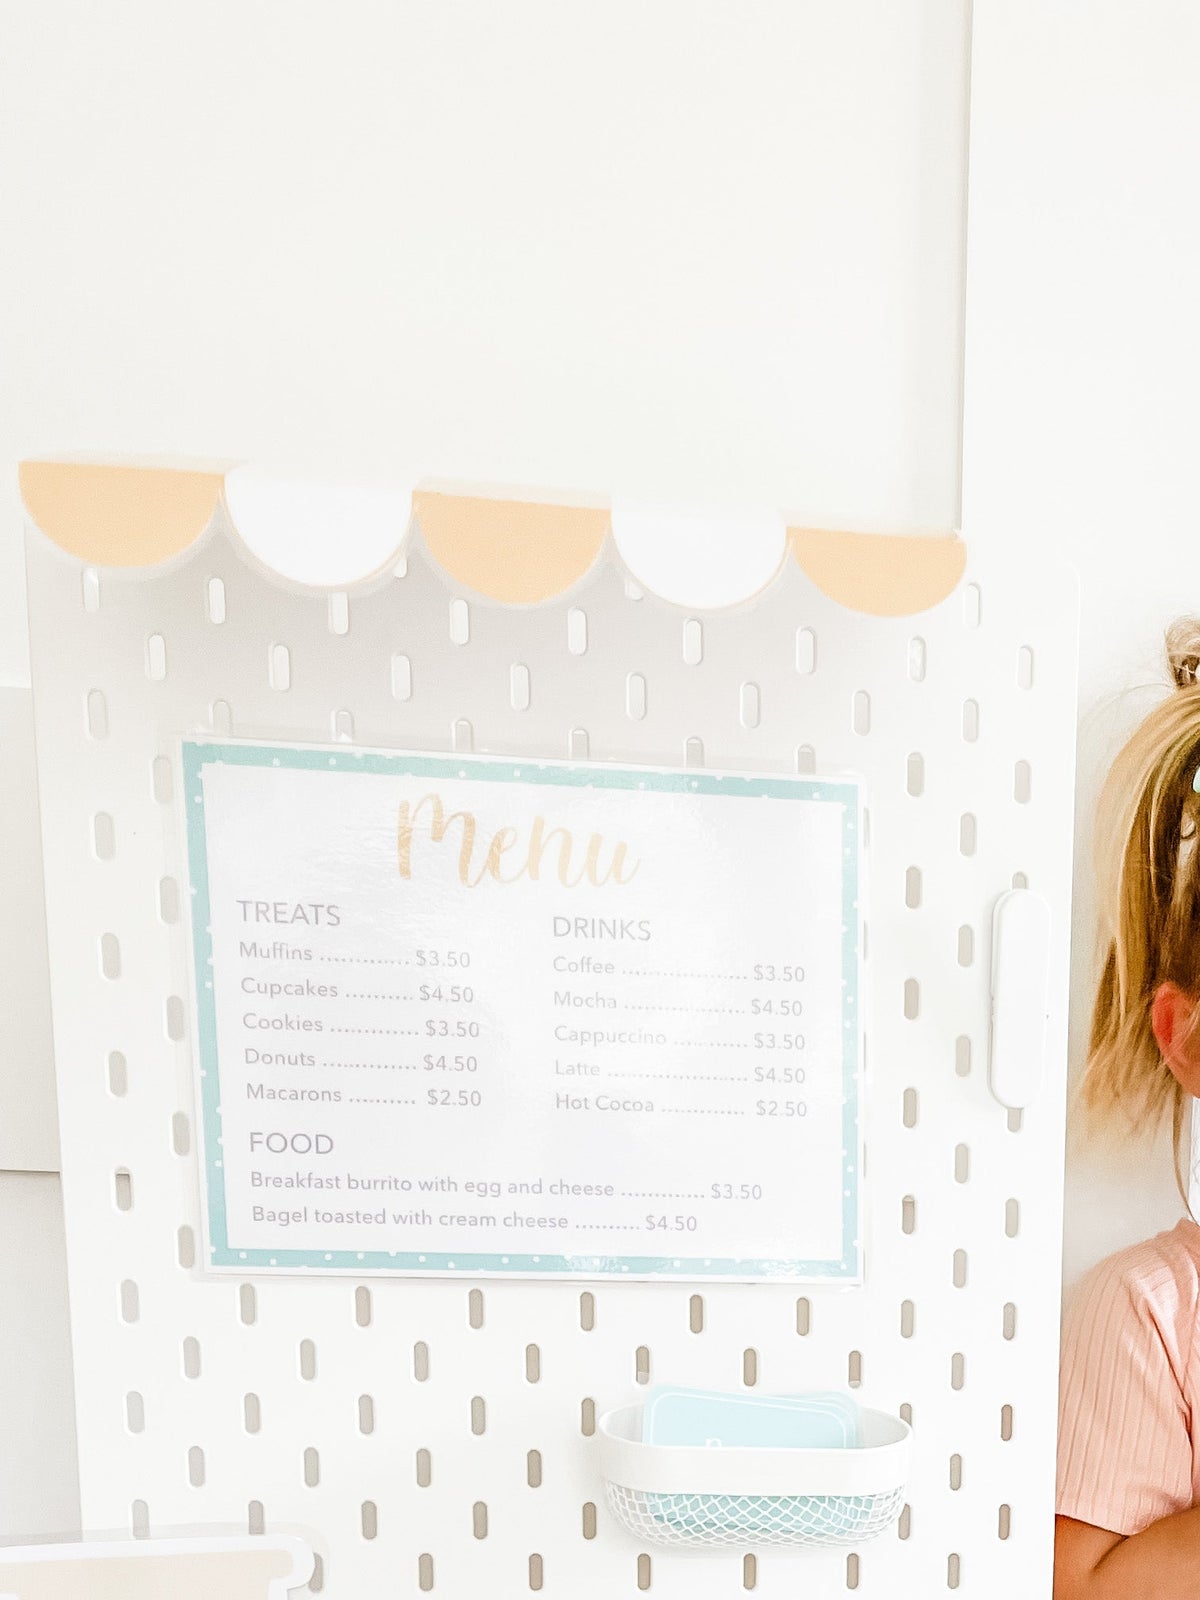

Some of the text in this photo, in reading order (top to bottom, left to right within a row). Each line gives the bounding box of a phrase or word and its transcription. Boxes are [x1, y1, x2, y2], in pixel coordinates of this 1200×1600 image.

[396, 792, 642, 889] Menu
[235, 899, 341, 927] TREATS
[552, 915, 652, 941] DRINKS
[239, 941, 471, 969] Muffins $3.50
[552, 956, 806, 983] Coffee $3.50
[240, 976, 474, 1004] Cupcakes $4.50
[552, 990, 803, 1017] Mocha $4.50
[242, 1011, 480, 1039] Cookies $3.50
[554, 1025, 806, 1051] Cappuccino $3.50
[244, 1047, 478, 1073] Donuts $4.50
[555, 1059, 806, 1084] Latte $4.50
[246, 1082, 482, 1107] Macarons $2.50
[556, 1092, 808, 1118] Hot Cocoa $2.50
[249, 1132, 335, 1155] FOOD
[250, 1171, 763, 1202] Breakfast burrito with egg and cheese $3.50
[252, 1205, 698, 1233] Bagel toasted with cream cheese $4.50
